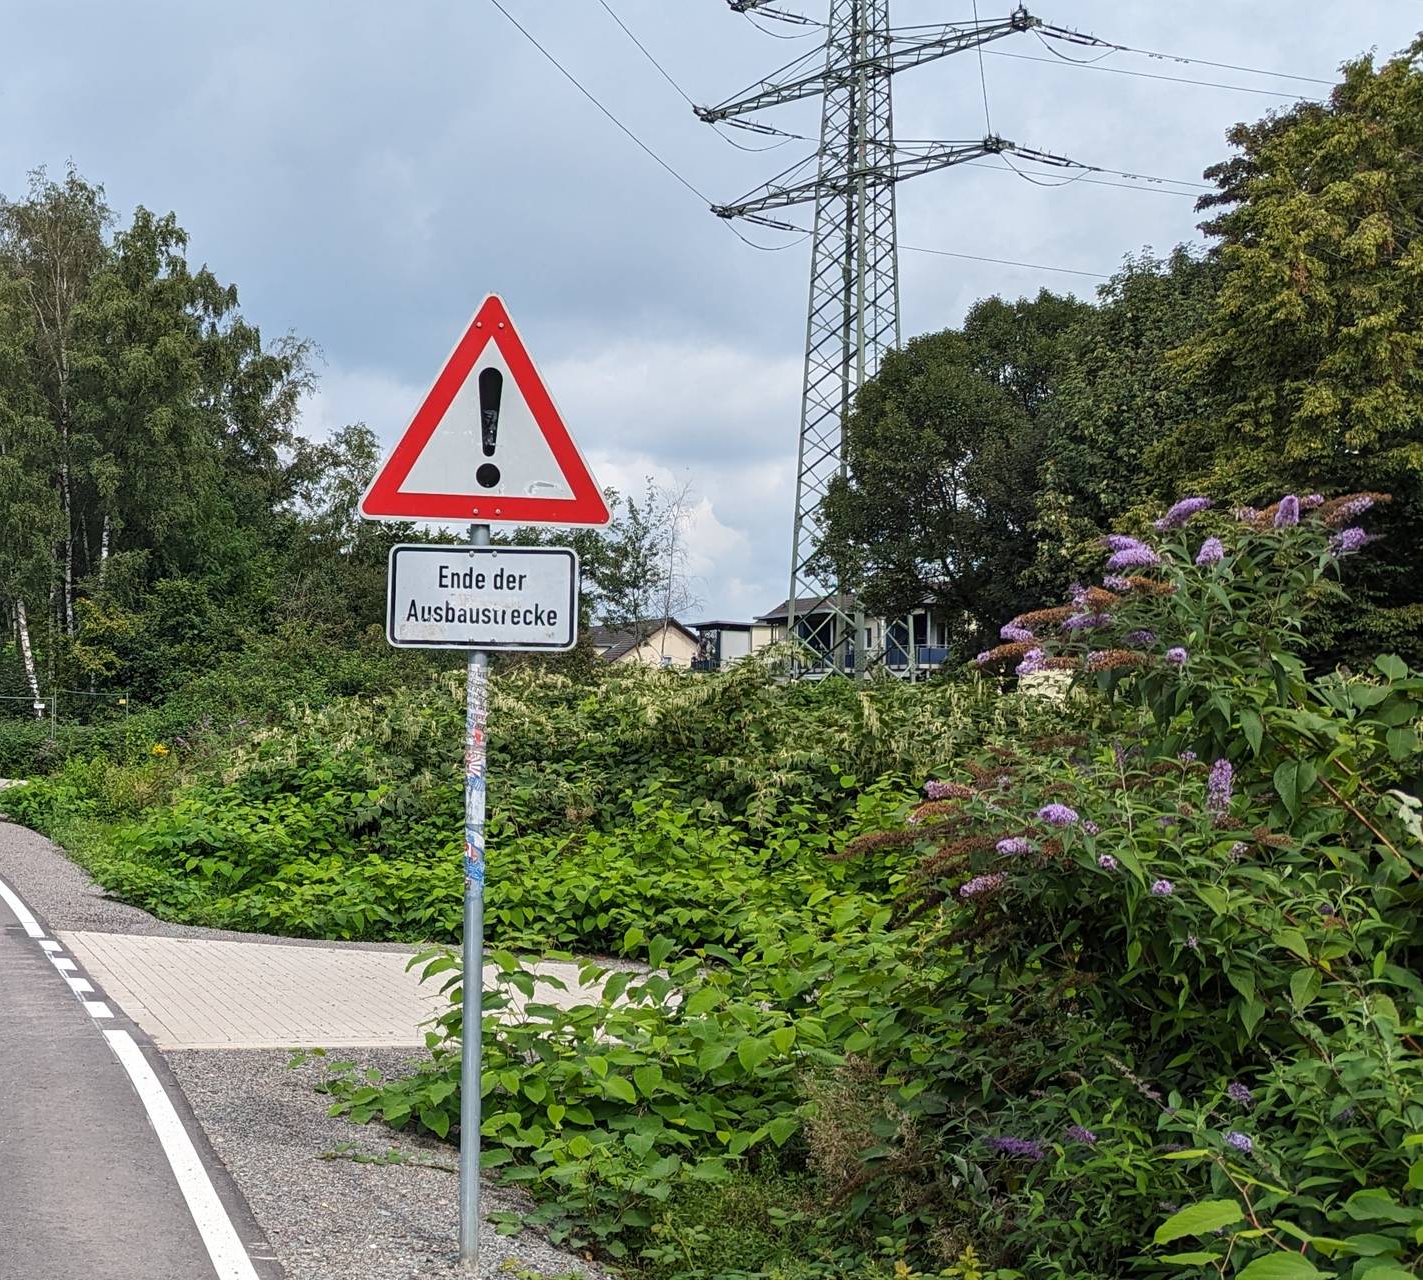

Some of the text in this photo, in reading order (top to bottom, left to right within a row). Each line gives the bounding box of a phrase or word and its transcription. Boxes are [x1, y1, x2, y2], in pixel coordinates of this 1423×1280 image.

[438, 565, 527, 591] Ende der
[406, 599, 558, 626] Ausbaustrecke
